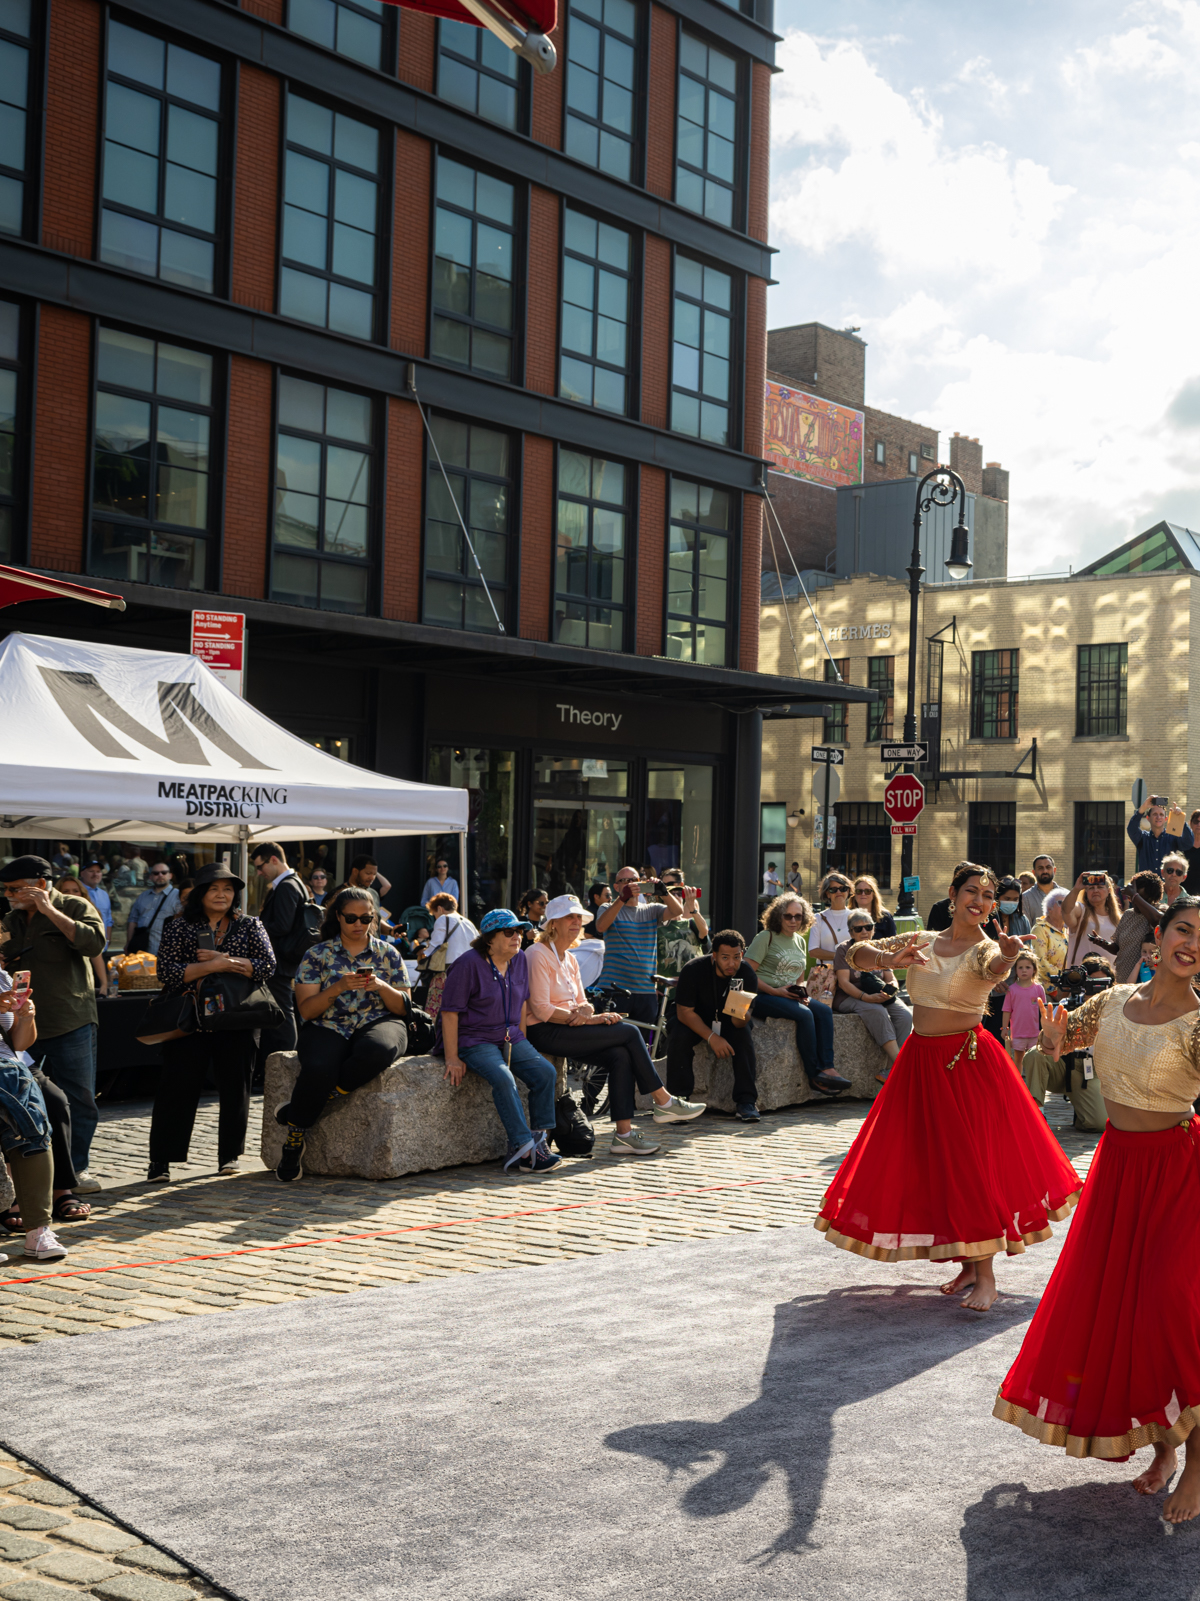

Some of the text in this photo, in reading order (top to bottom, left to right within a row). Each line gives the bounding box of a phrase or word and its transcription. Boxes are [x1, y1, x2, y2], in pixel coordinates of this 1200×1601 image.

[195, 621, 222, 629] Anytime
[206, 615, 237, 623] STANDING
[204, 642, 235, 650] STANDING
[556, 704, 622, 731] Theory
[887, 748, 921, 757] ONE WAY
[158, 781, 288, 805] MEATPACKING
[886, 789, 922, 808] STOP
[185, 800, 264, 819] DISTRICT
